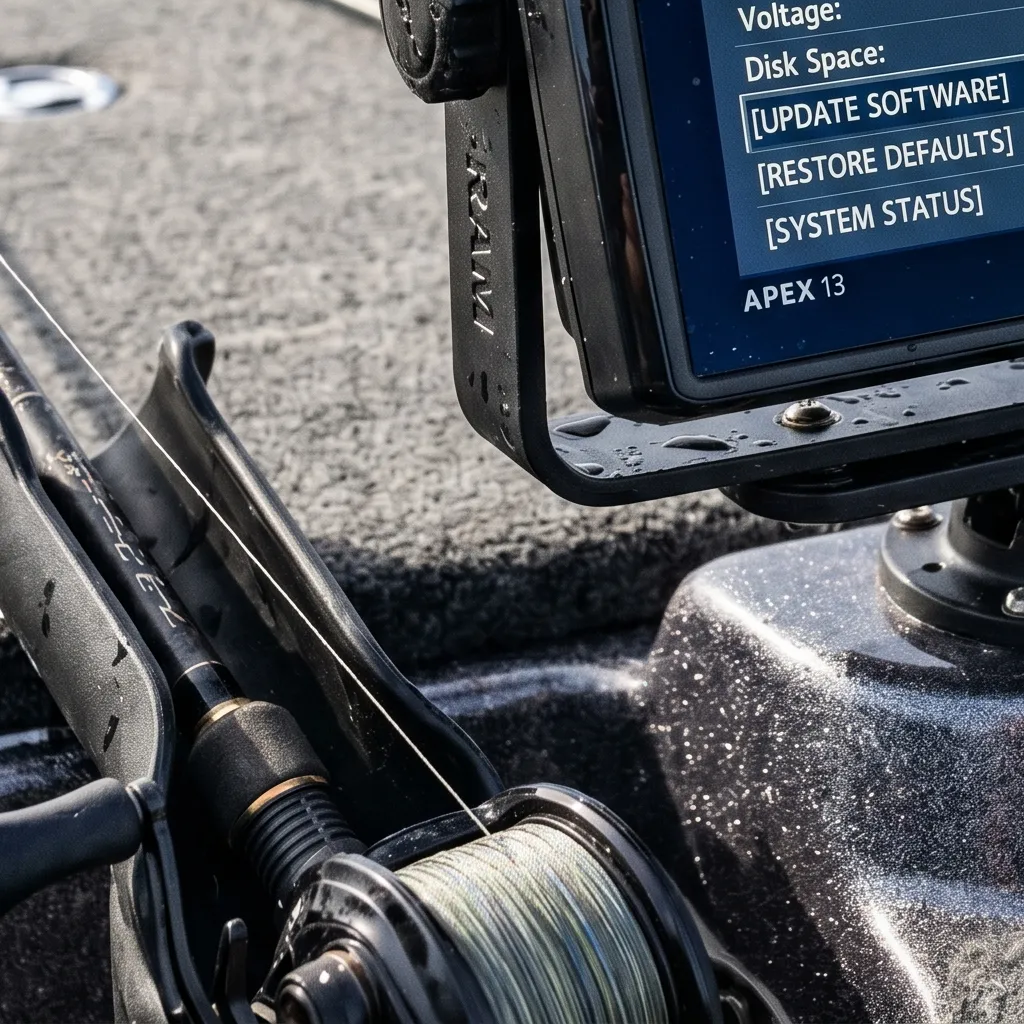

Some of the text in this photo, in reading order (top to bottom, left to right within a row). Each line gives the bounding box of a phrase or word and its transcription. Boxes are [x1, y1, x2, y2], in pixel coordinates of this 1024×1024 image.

[738, 2, 841, 34] Voltage:
[745, 51, 798, 81] Disk
[807, 46, 885, 78] Space:
[752, 73, 1010, 141] [UPDATE SOFTWARE]
[758, 126, 1014, 195] [RESTORE DEFAULTS]
[766, 184, 983, 250] [SYSTEM STATUS]
[744, 274, 845, 312] APEX 13
